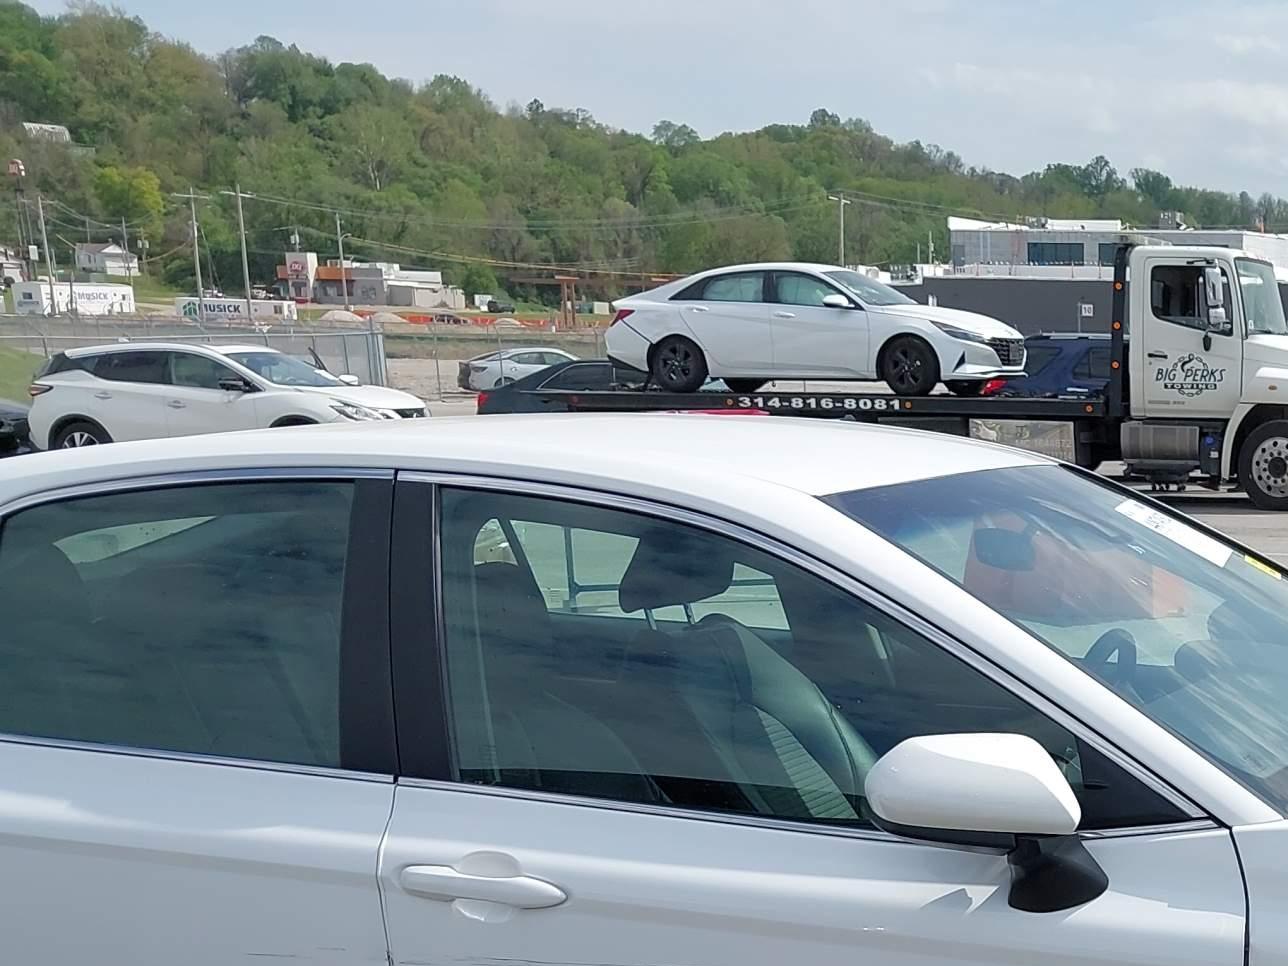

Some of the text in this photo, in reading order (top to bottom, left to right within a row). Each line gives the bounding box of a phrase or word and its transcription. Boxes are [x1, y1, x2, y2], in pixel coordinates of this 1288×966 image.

[1155, 368, 1226, 382] BIG PERKS
[738, 397, 900, 410] 314-816-8081
